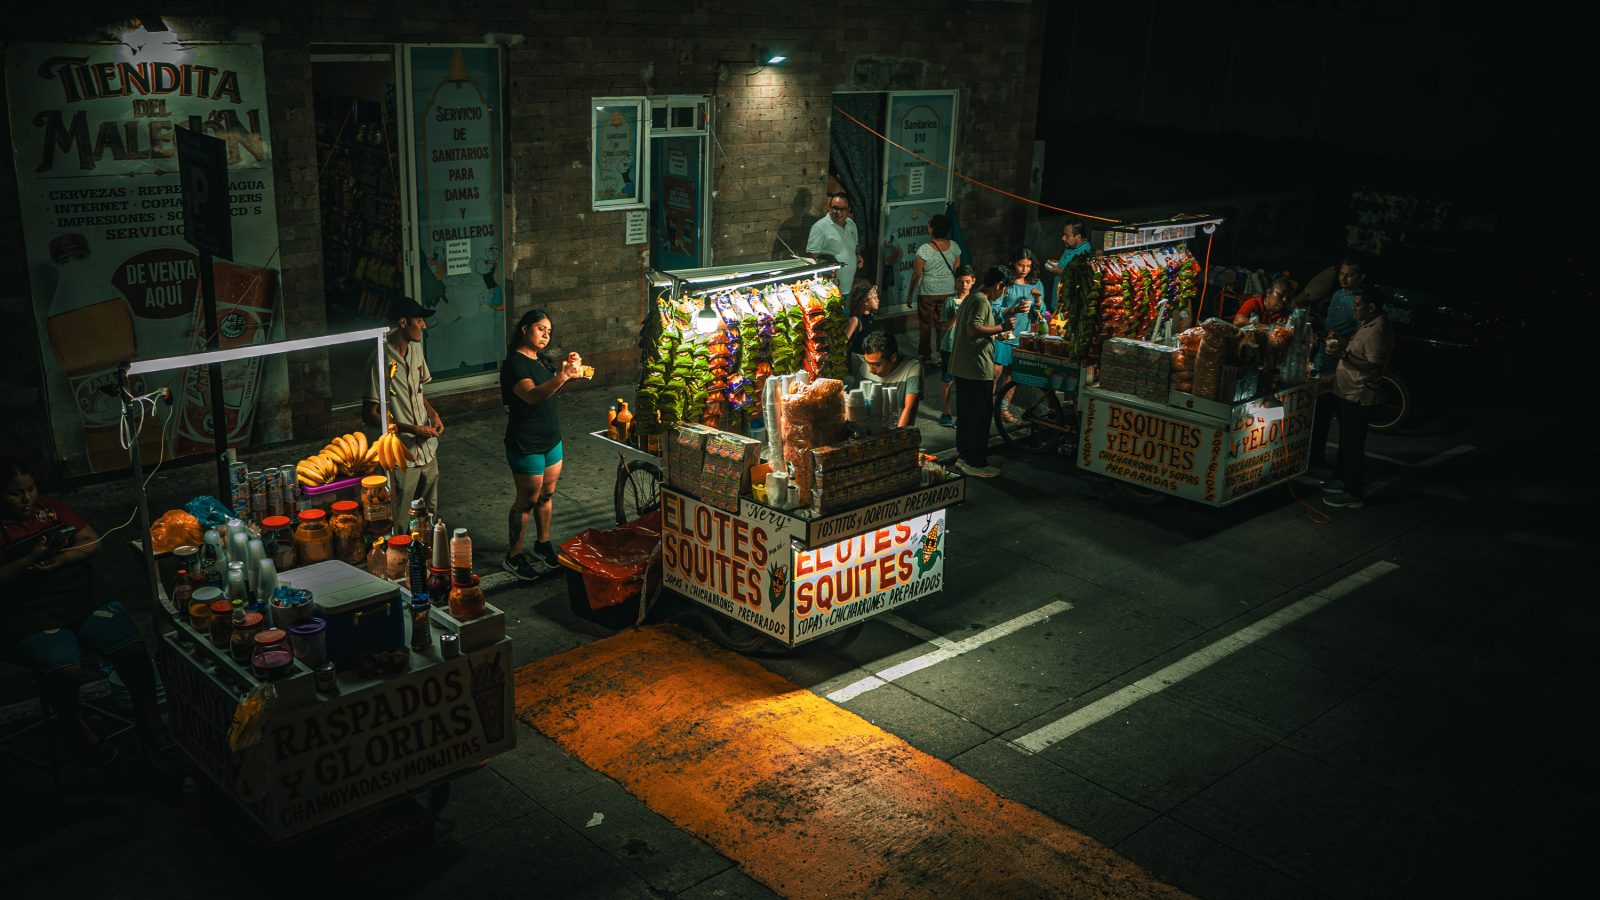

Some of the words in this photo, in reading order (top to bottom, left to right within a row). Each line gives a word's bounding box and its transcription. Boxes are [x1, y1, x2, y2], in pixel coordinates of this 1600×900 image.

[38, 55, 243, 104] TIENDITA
[132, 99, 172, 118] DEL
[436, 105, 482, 122] SERVICIO
[453, 128, 467, 141] DE
[904, 119, 938, 130] Sanitarios
[33, 108, 265, 171] MALEN
[432, 147, 489, 163] SANITARIOS
[448, 167, 474, 181] PARA
[49, 187, 126, 201] CERVEZAS
[137, 184, 184, 197] REFRE
[229, 181, 265, 191] AGUA
[54, 201, 129, 215] INTERNET
[141, 198, 184, 209] COPIA
[229, 193, 263, 204] DERS
[445, 187, 480, 201] DAMAS
[58, 213, 155, 227] IMPRESIONES
[460, 207, 466, 220] Y
[432, 224, 494, 242] CABALLEROS
[898, 224, 928, 239] SANITARI
[126, 264, 148, 285] DE
[150, 259, 198, 283] VENTA
[145, 281, 183, 309] AQUÍ
[1107, 403, 1201, 449] ESQUITES
[1098, 450, 1159, 474] CHICHARRONES
[1162, 468, 1168, 476] Y
[1169, 471, 1200, 486] SOPAS
[1105, 463, 1178, 491] PREPARADAS
[817, 512, 858, 540] TOSTITOS
[903, 485, 960, 514] PREPARADOS
[662, 490, 768, 571] ELOTES
[662, 531, 762, 611] SQUITES
[794, 549, 914, 618] SQUITES
[664, 572, 683, 589] SOPAS
[689, 583, 734, 614] CHICHARRONES
[738, 605, 786, 636] PREPARADOS
[796, 614, 823, 637] SOPAS
[829, 592, 885, 626] CHICHARRONES
[888, 573, 942, 605] PREPARADOS
[272, 668, 463, 762] RASPADOS
[278, 767, 307, 799] Y
[315, 704, 472, 786] GLORIAS
[281, 771, 391, 827] CHAMOYADAS
[401, 737, 481, 781] MONJITAS
